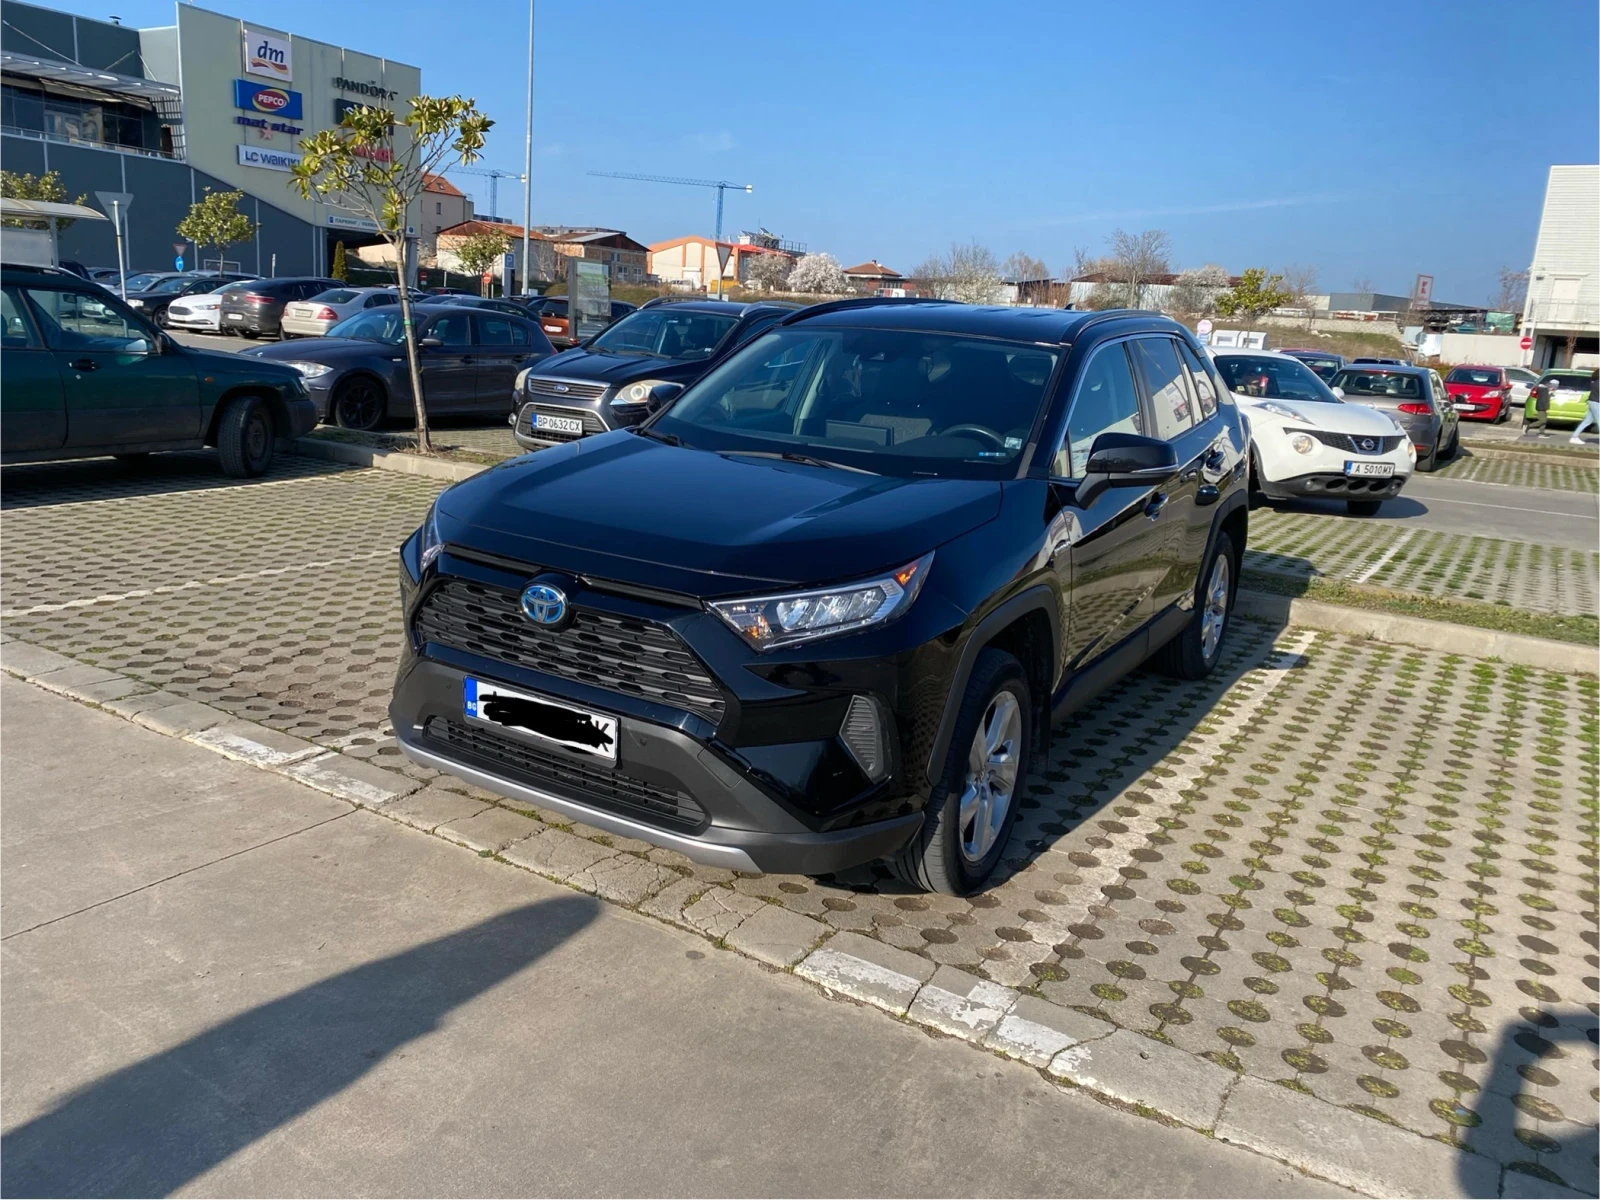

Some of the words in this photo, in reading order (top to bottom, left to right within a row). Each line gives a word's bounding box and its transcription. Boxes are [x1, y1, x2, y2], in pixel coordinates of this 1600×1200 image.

[257, 41, 285, 63] dm
[335, 77, 398, 101] PANDORA
[258, 94, 285, 107] PEPCO
[236, 116, 267, 129] mat
[271, 123, 304, 135] star
[245, 151, 259, 162] LC
[506, 255, 513, 266] P
[538, 416, 548, 427] BP
[548, 418, 568, 430] 0632
[569, 420, 580, 432] CX
[467, 701, 476, 711] BG
